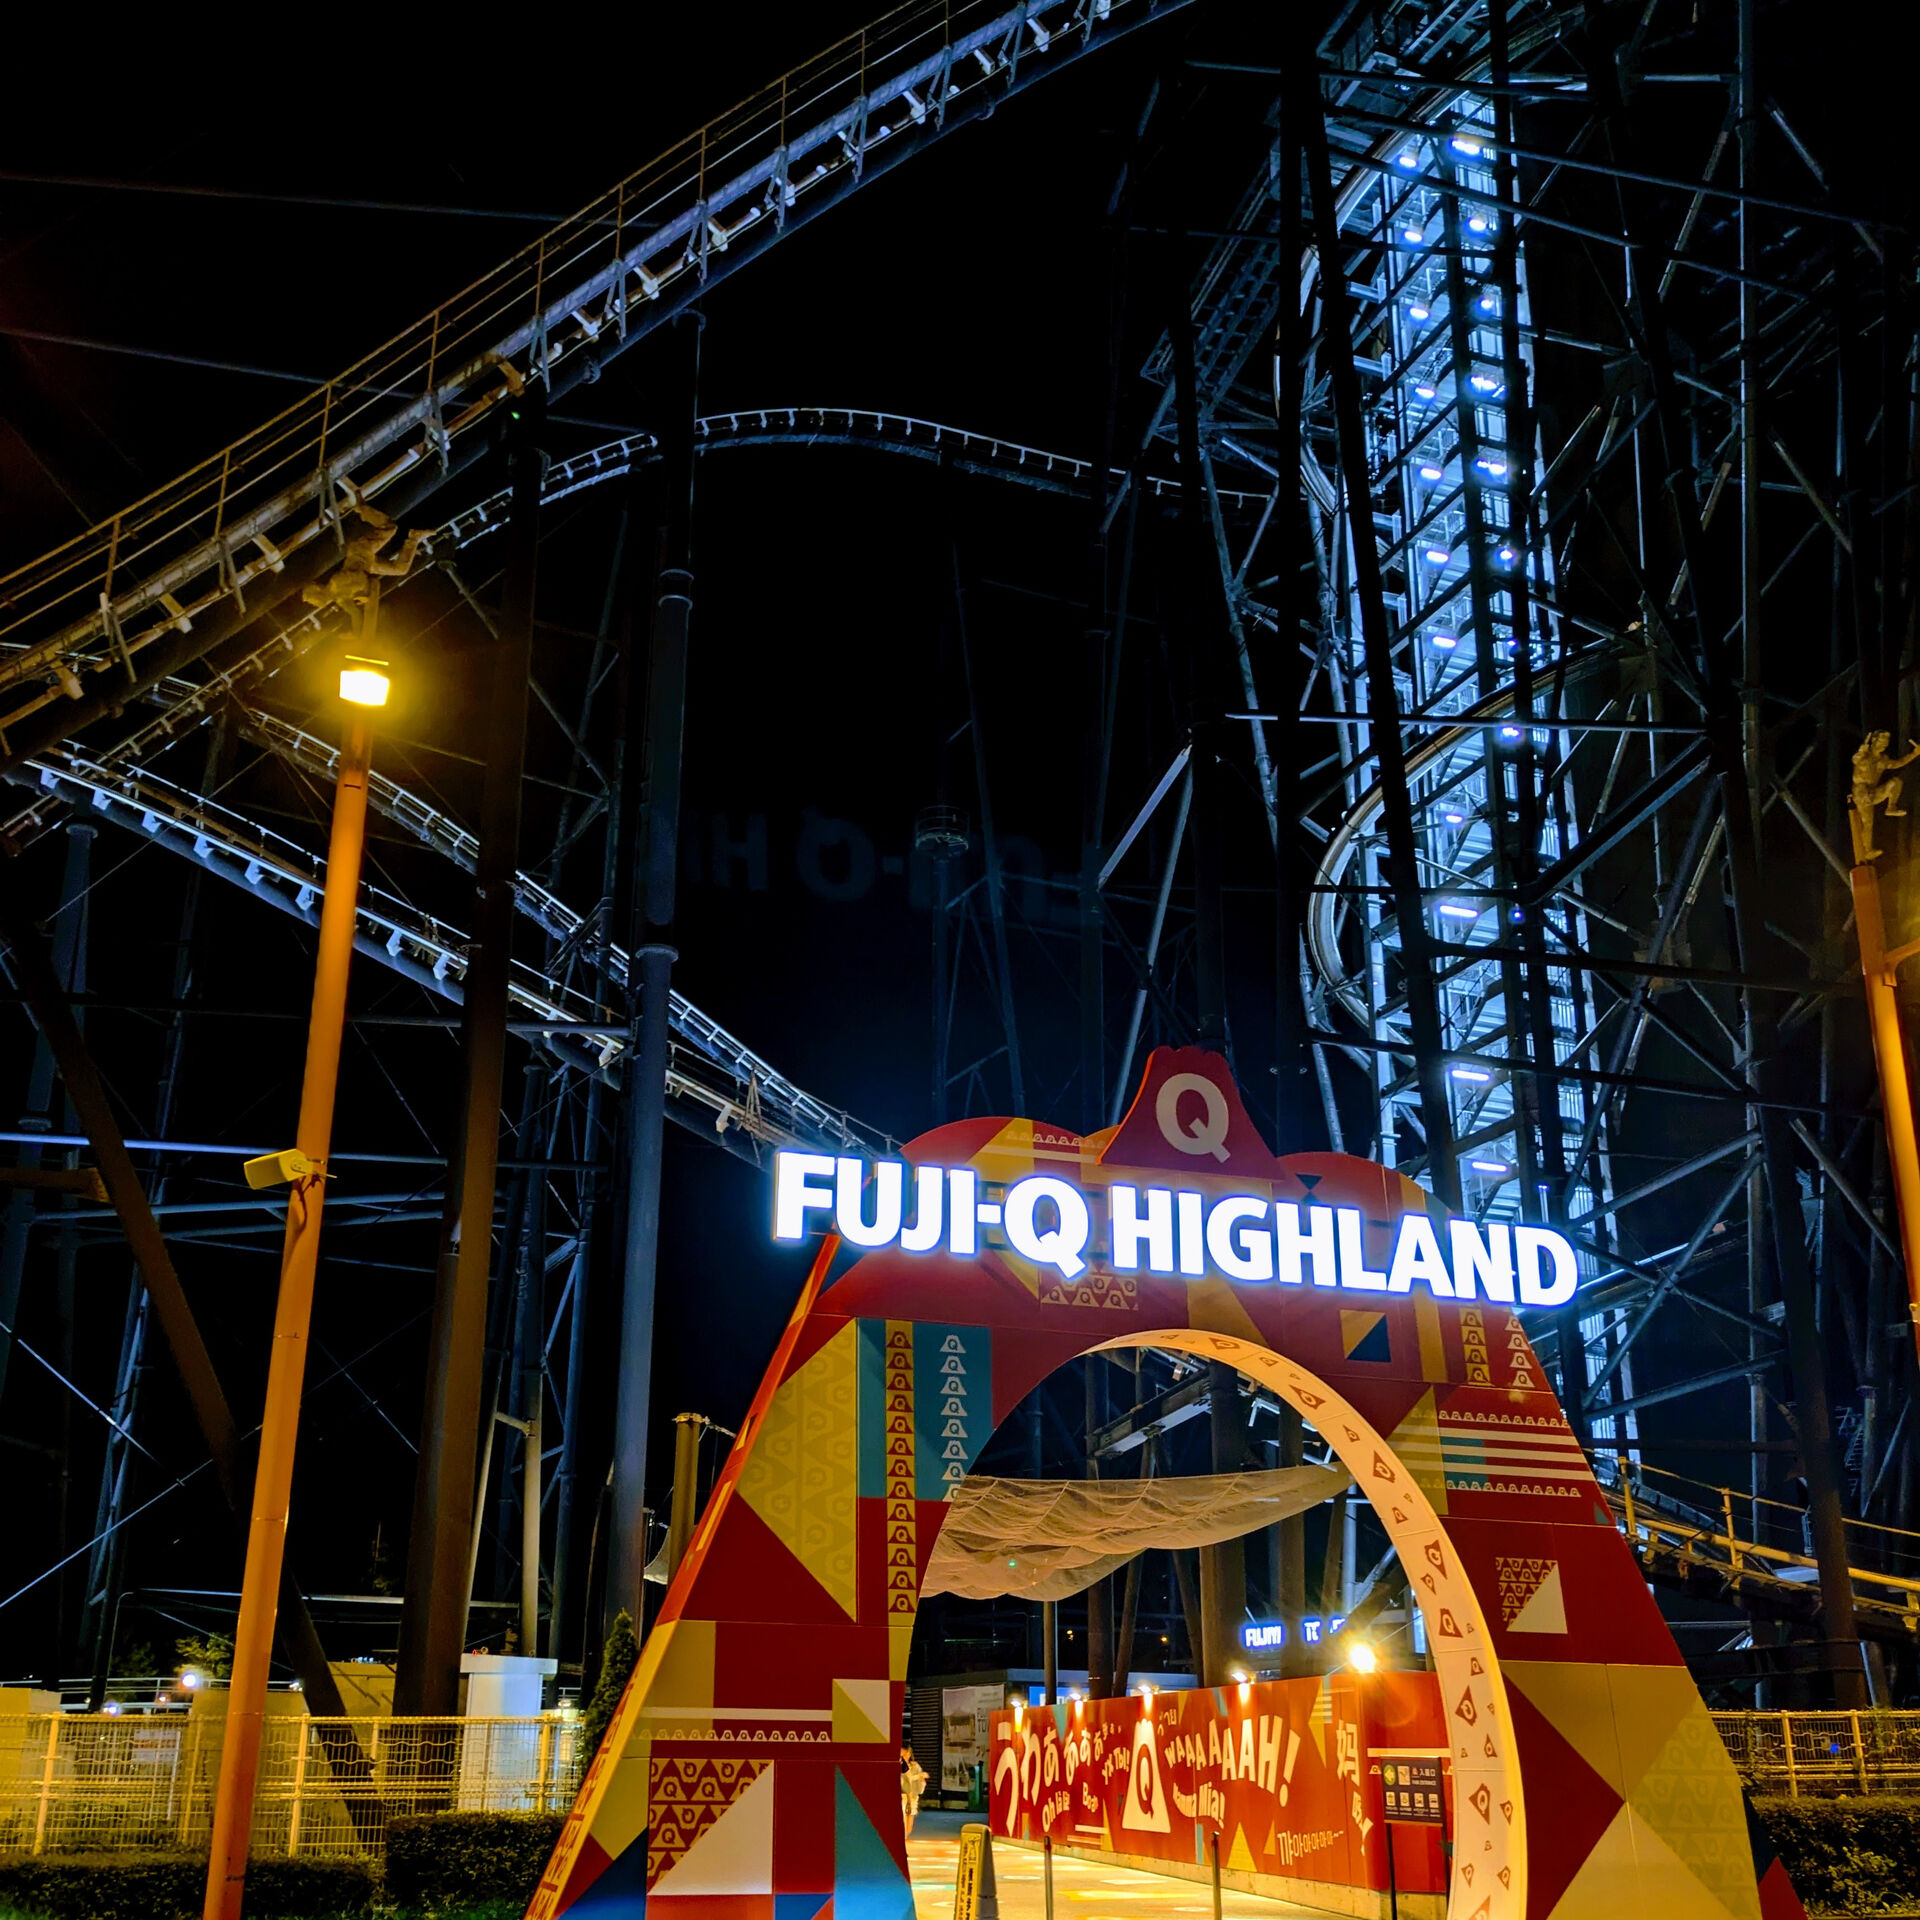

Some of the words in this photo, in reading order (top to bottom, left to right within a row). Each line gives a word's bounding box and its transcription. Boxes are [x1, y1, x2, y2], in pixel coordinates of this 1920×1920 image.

[1156, 1072, 1231, 1163] Q
[774, 1152, 1089, 1279] FUJI-Q
[1110, 1184, 1578, 1307] HIGHLAND
[1135, 1743, 1155, 1820] Q
